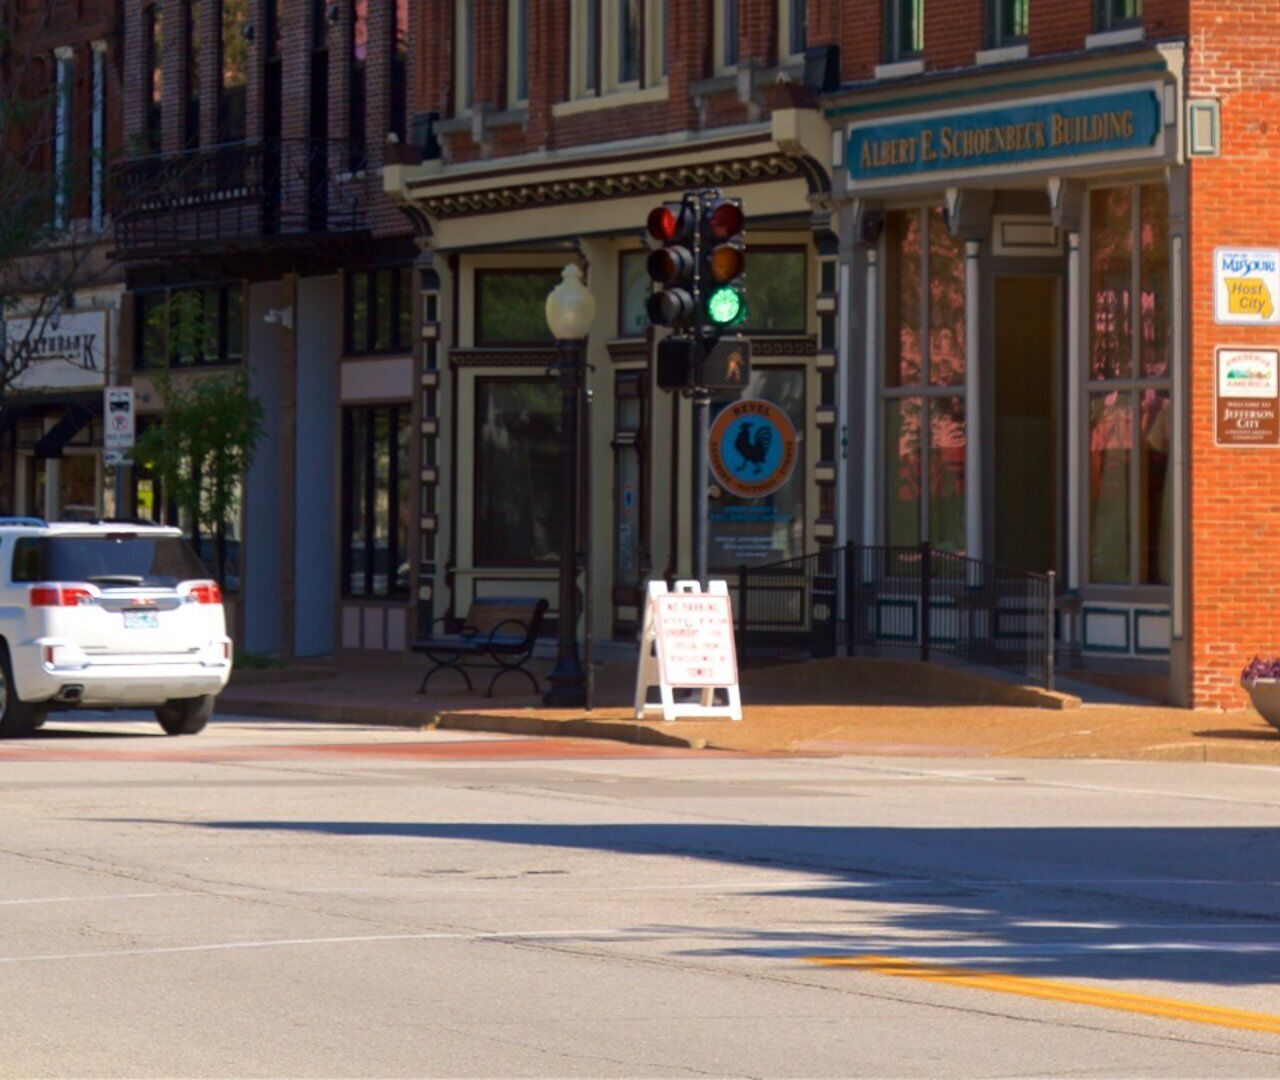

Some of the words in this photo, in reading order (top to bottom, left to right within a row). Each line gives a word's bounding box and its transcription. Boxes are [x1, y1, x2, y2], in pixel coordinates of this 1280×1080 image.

[861, 137, 917, 168] ALBERT
[921, 129, 937, 161] E.
[940, 121, 1046, 159] SCHOENBECK
[1050, 109, 1134, 146] BUILDING
[1231, 282, 1263, 295] Host
[1239, 296, 1266, 313] City
[1223, 408, 1275, 421] JEFFERSON
[1236, 419, 1261, 429] CITY
